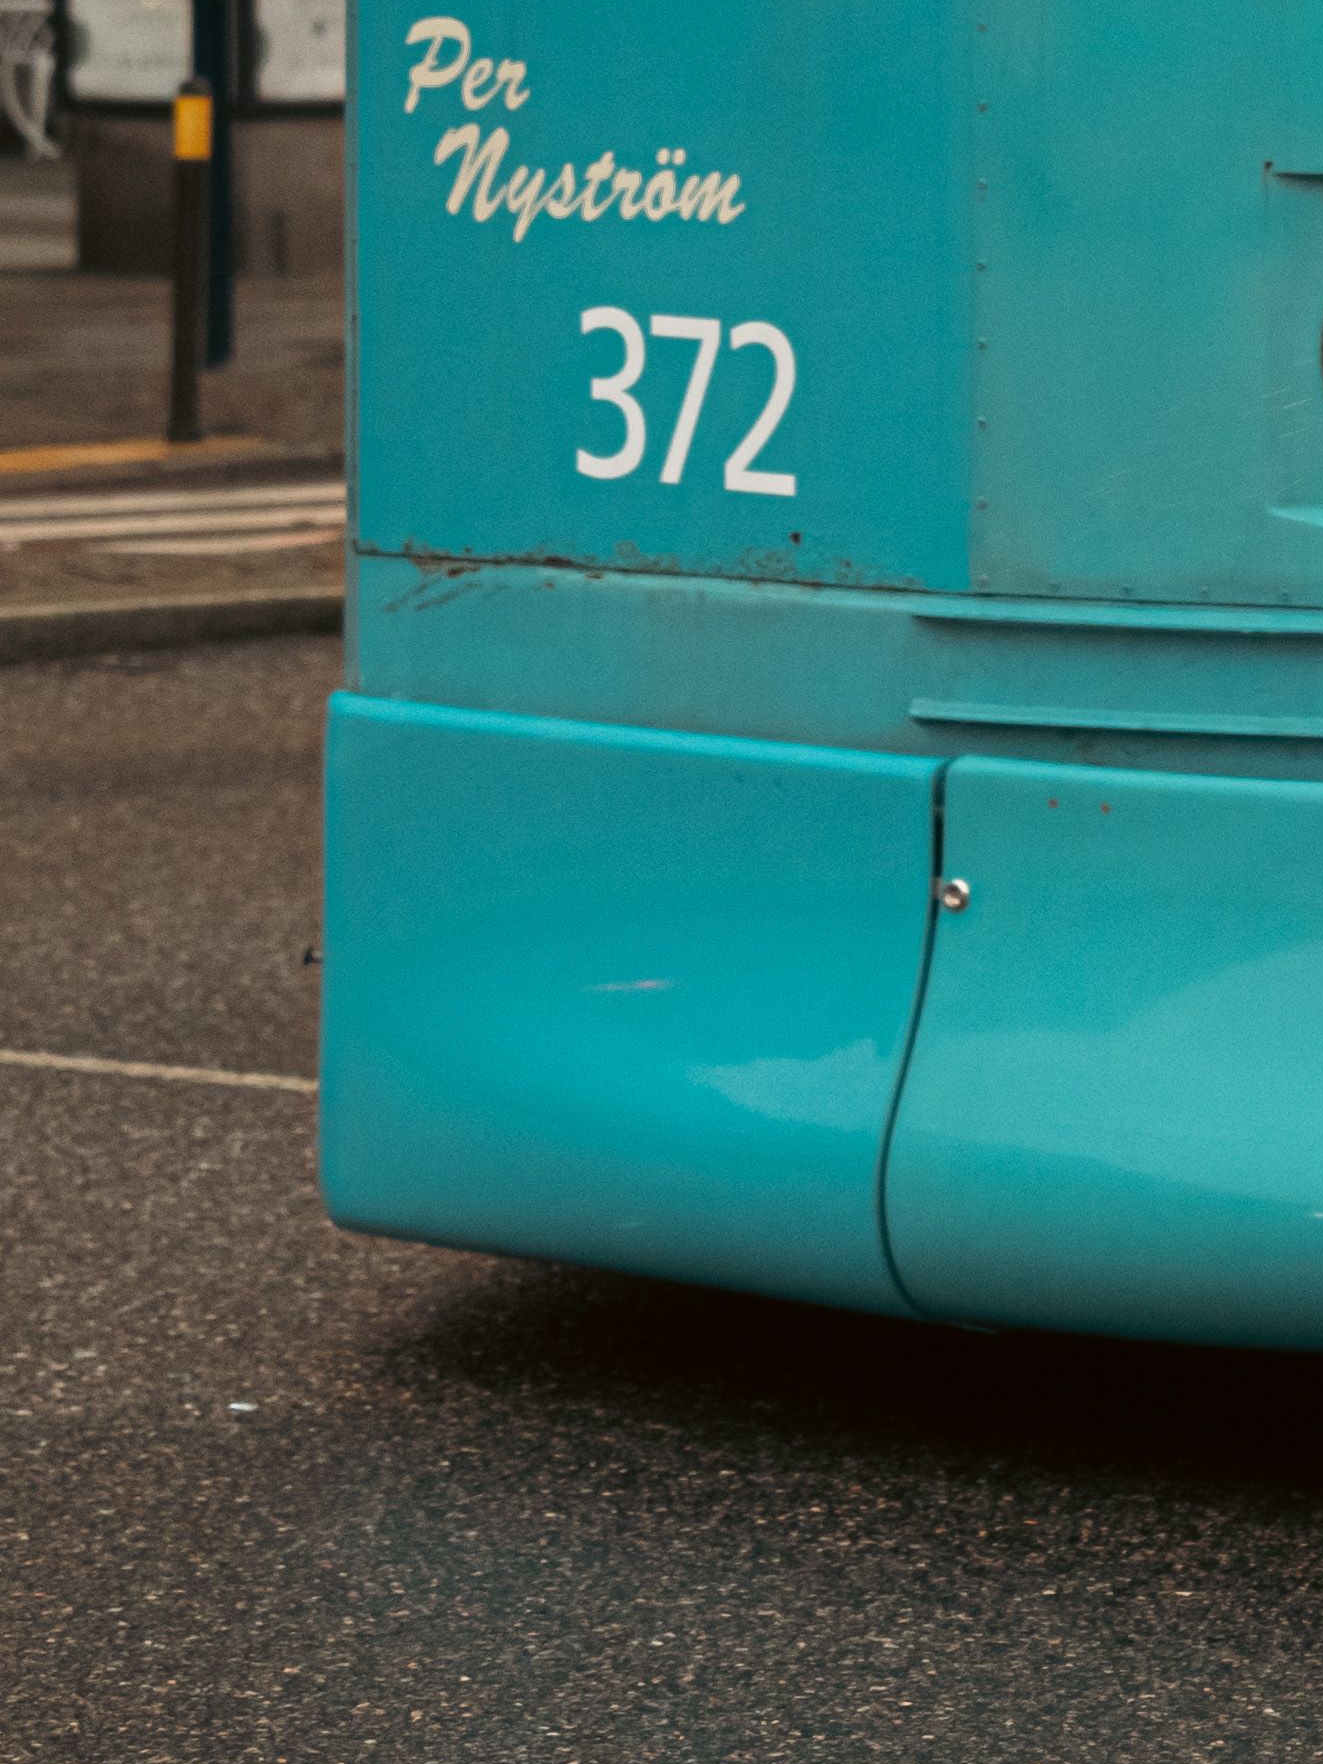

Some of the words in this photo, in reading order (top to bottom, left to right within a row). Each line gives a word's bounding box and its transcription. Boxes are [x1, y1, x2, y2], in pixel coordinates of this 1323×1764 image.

[405, 16, 530, 114] Per
[434, 123, 745, 243] Nyström
[576, 305, 796, 496] 372
